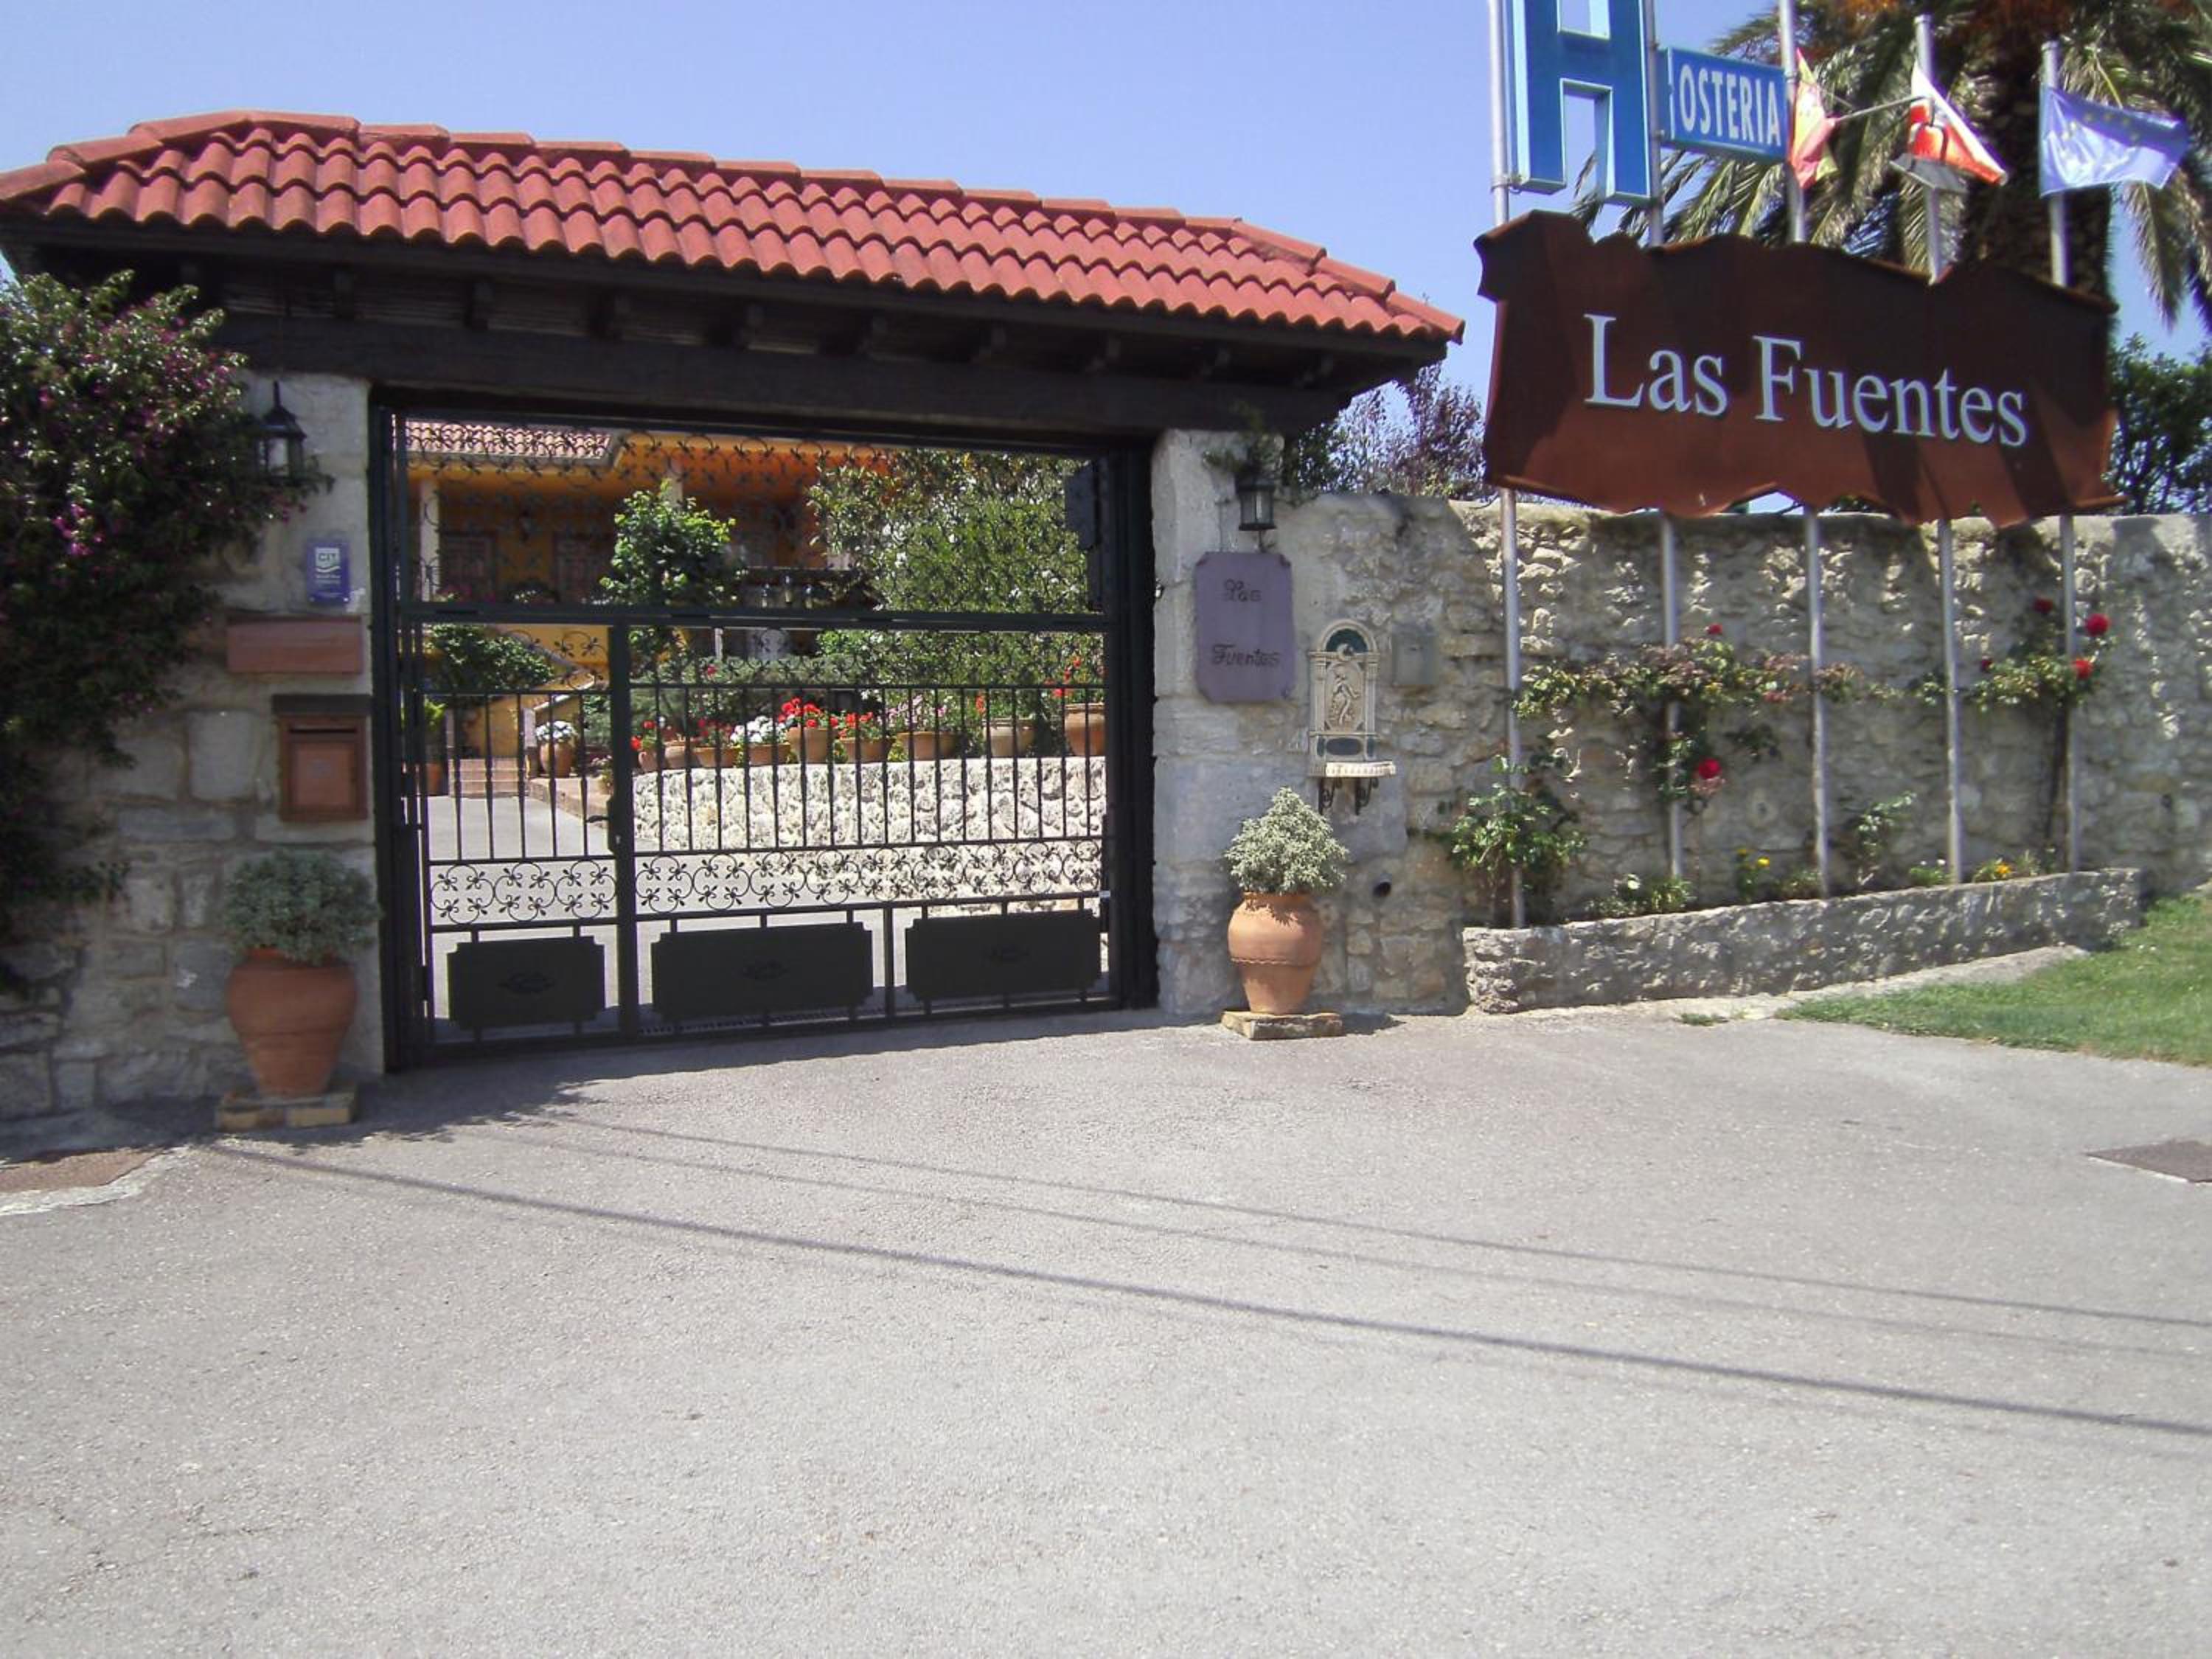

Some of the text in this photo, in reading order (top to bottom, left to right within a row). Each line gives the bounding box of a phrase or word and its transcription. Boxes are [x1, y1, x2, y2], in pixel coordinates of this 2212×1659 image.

[1679, 63, 1782, 147] OSTERIA
[1584, 313, 2028, 448] Las Fuentes
